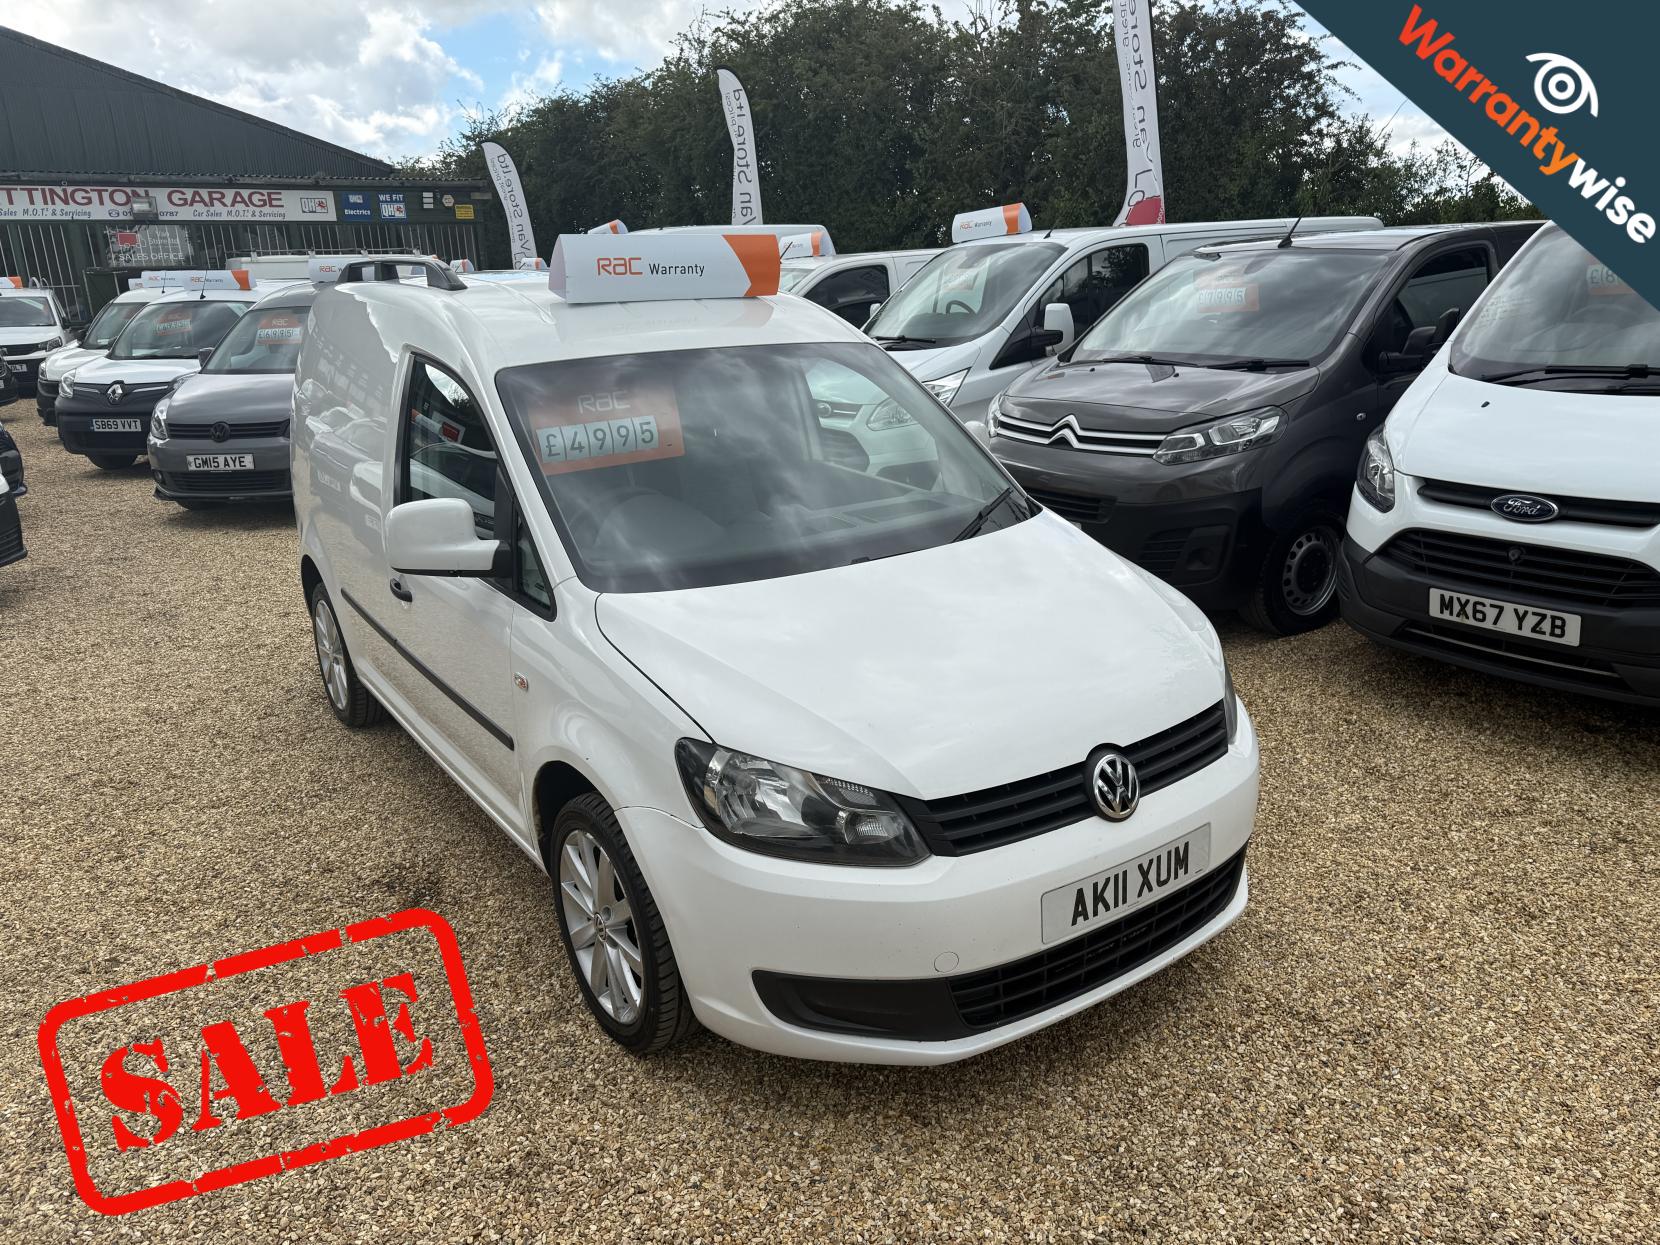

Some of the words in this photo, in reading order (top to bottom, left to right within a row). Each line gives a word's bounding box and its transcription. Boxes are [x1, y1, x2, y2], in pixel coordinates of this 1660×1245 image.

[167, 190, 284, 208] GARAGE
[60, 208, 92, 219] Servicing
[193, 210, 204, 218] Car
[206, 210, 223, 218] Sales
[259, 210, 286, 220] Servicing
[119, 253, 148, 261] SALES
[649, 263, 705, 277] Warranty
[94, 420, 119, 430] SB69
[120, 420, 139, 430] VVT
[545, 421, 654, 457] £4995
[193, 456, 220, 469] GM15
[223, 456, 247, 468] AYE
[1503, 498, 1541, 516] Ford
[1439, 593, 1504, 626] MX67
[1513, 608, 1567, 639] YZB
[1071, 869, 1128, 926] AK11
[1137, 841, 1190, 898] XUM
